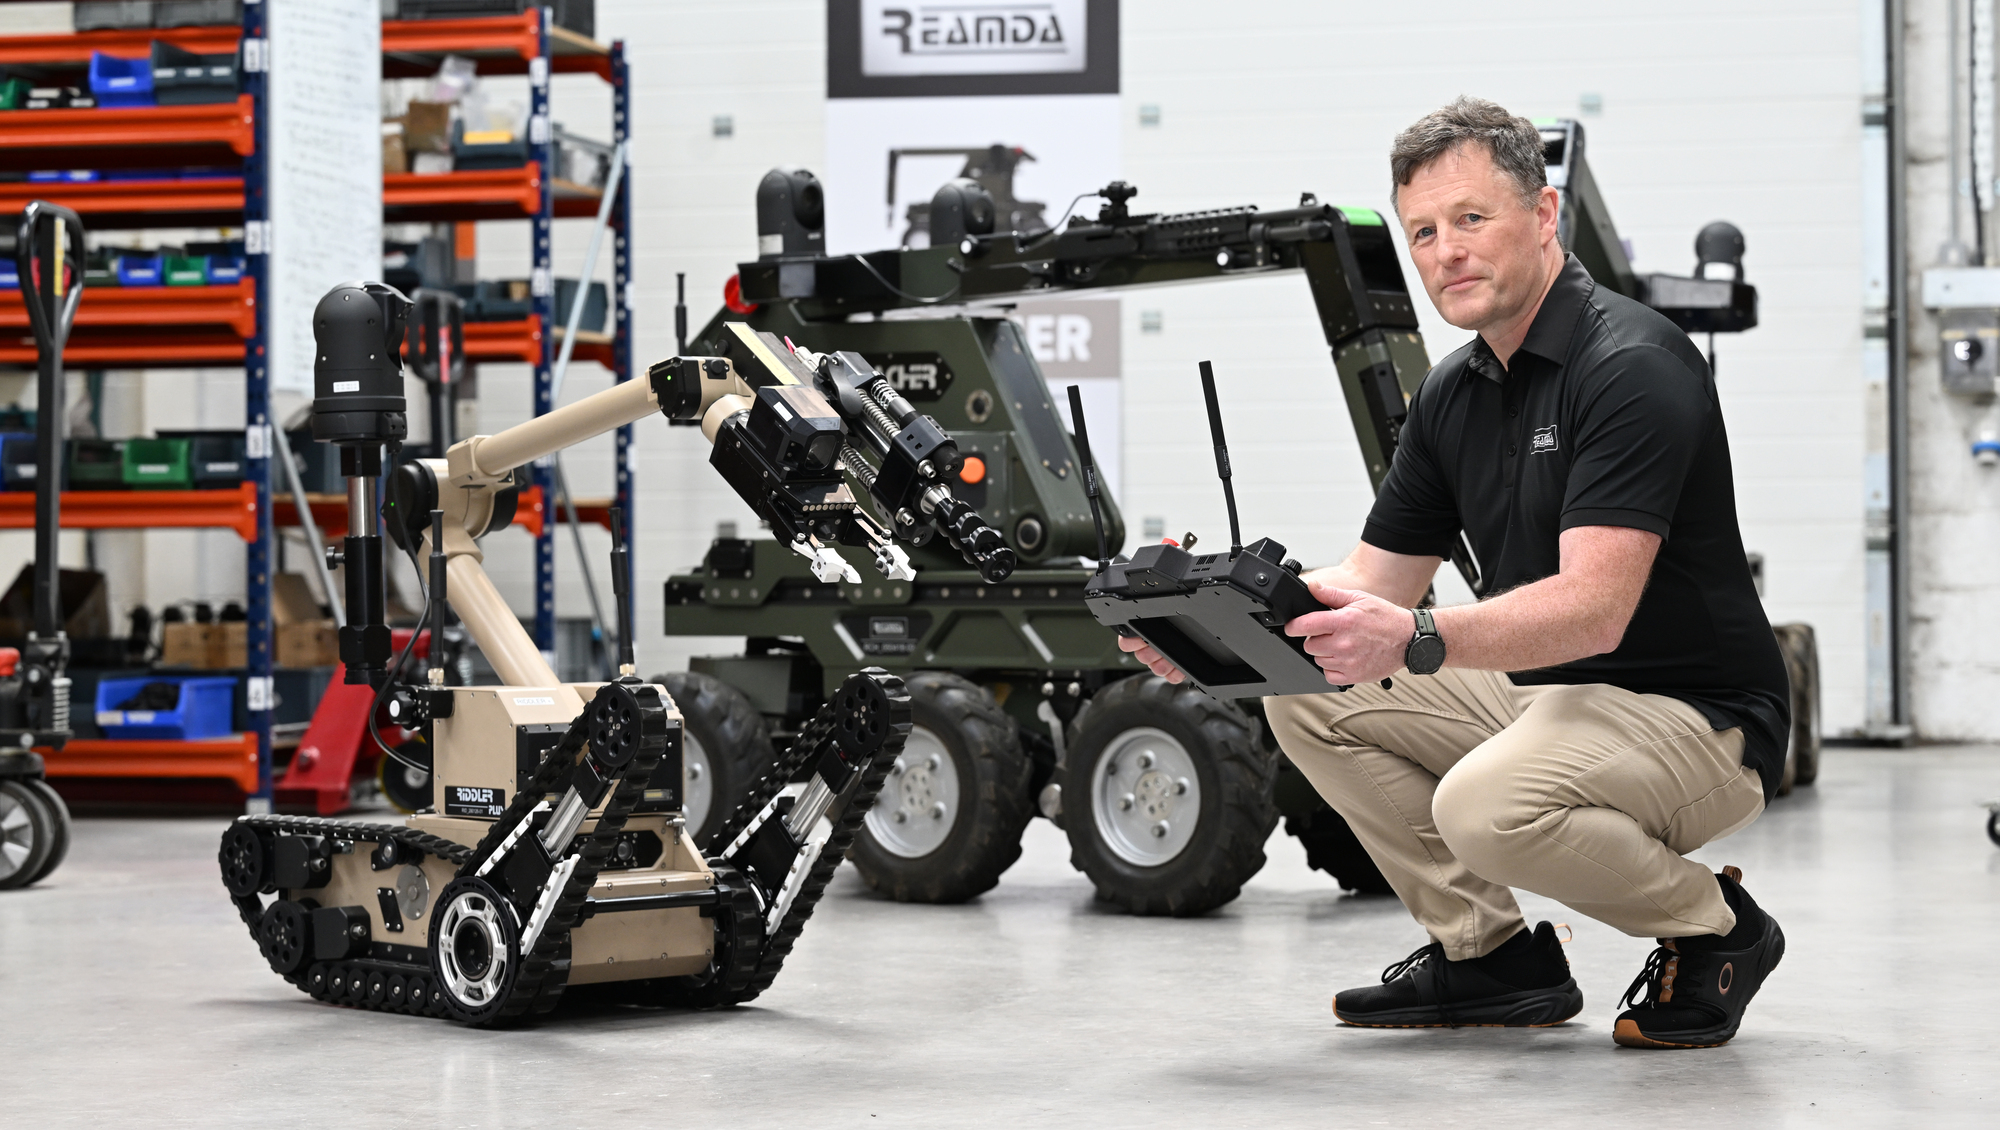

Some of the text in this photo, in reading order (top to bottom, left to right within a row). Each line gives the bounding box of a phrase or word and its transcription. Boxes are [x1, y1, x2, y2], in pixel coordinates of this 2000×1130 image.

[883, 9, 1064, 53] REAMDA
[1010, 314, 1092, 362] ER
[875, 364, 938, 390] CHER
[457, 787, 493, 803] RIDDLER
